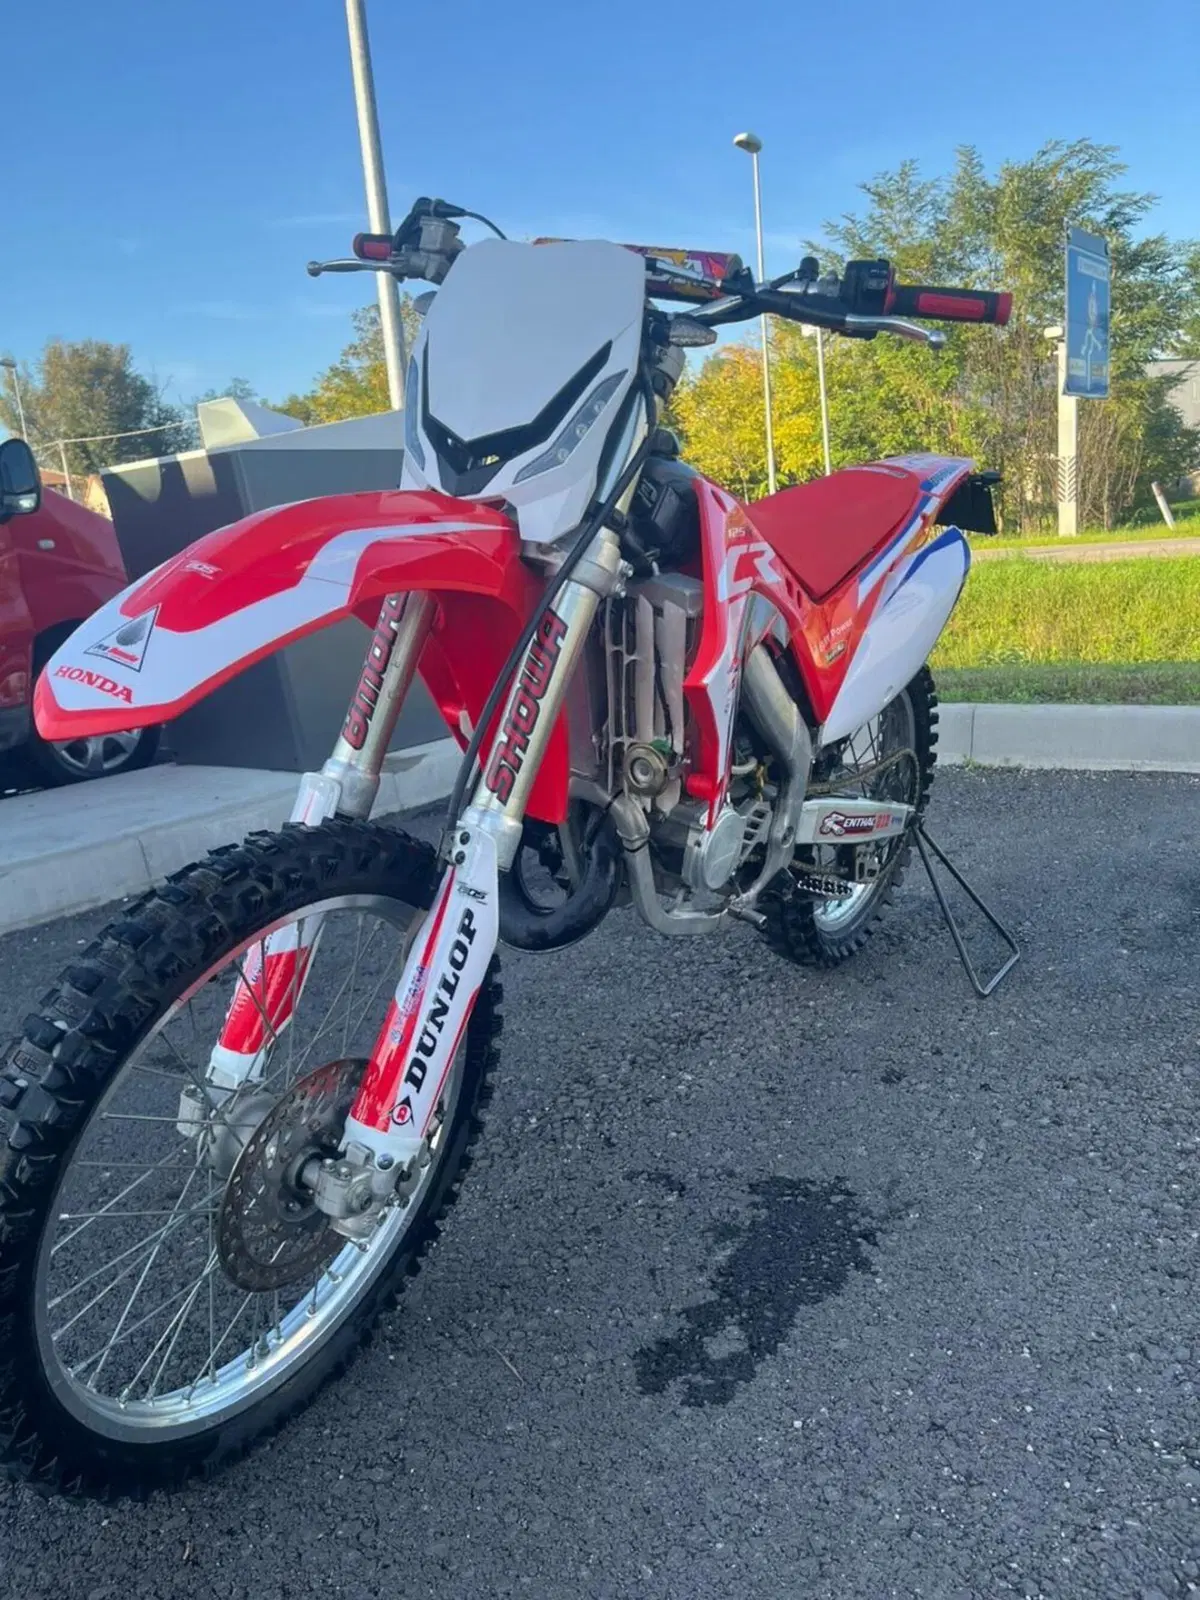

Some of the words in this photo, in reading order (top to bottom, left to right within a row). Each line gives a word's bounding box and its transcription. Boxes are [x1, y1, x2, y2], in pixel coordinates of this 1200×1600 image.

[53, 664, 133, 704] HONDA
[485, 606, 570, 807] SHOWA
[404, 907, 477, 1094] DUNLOP
